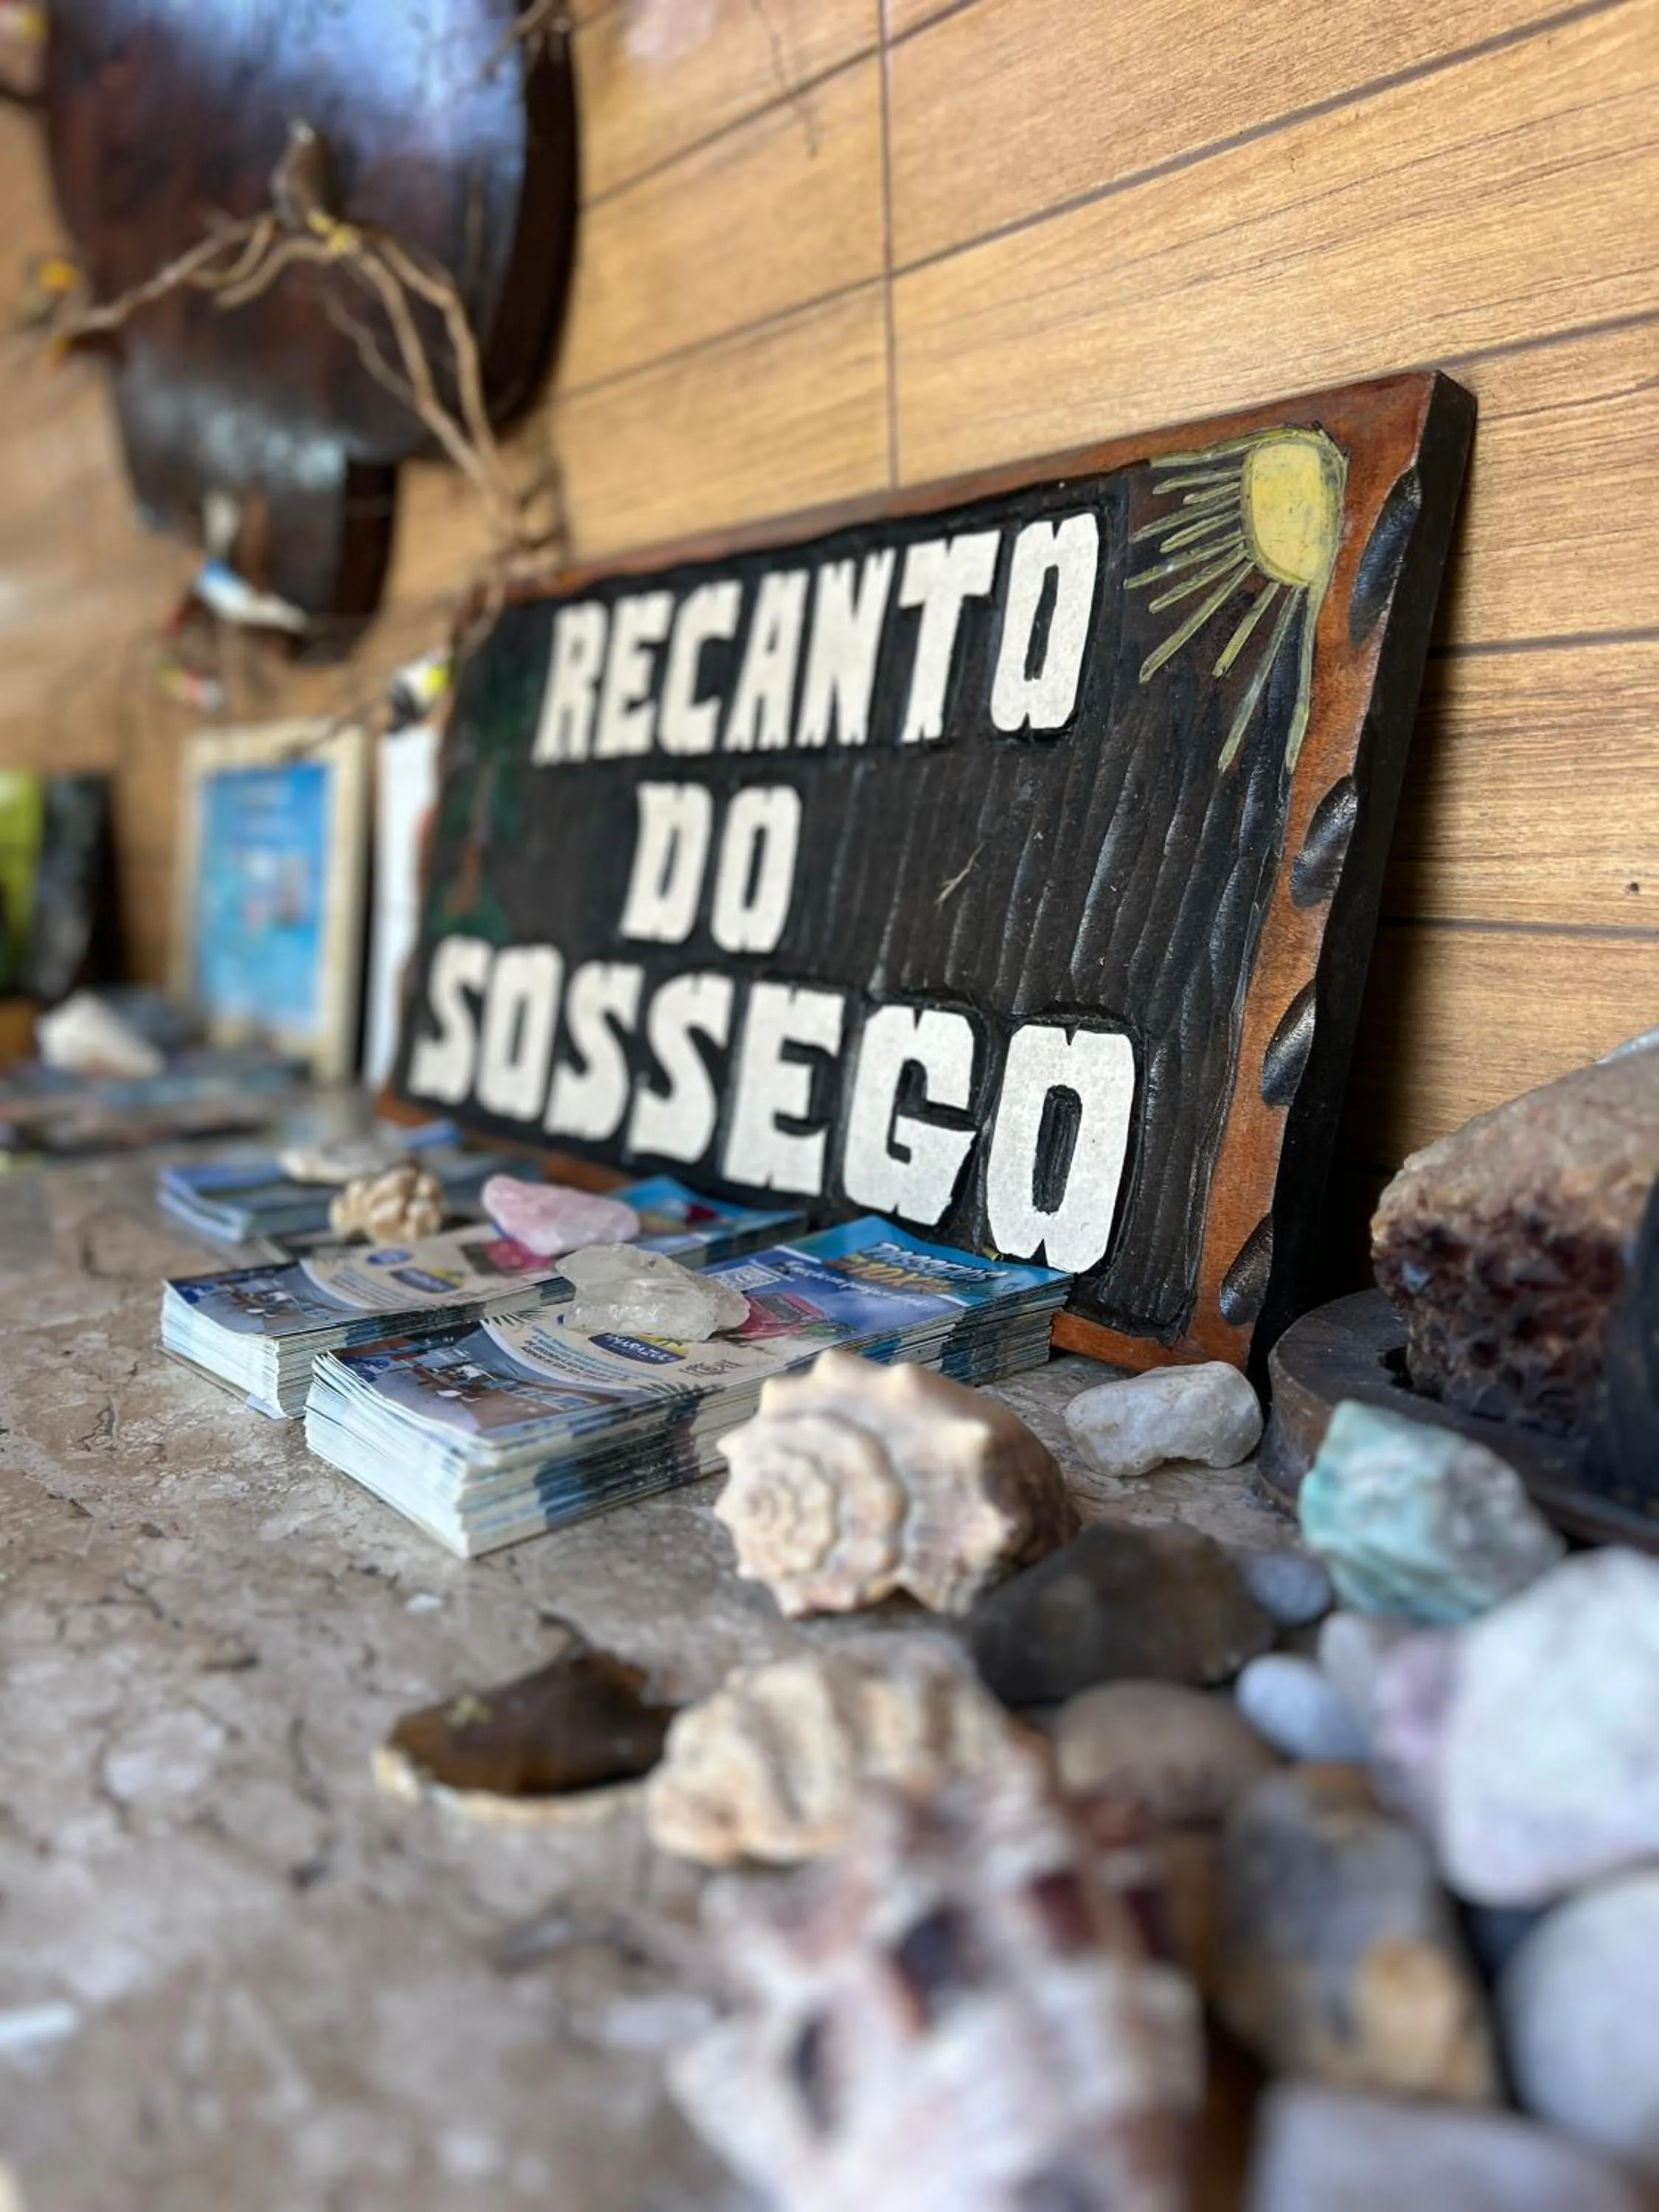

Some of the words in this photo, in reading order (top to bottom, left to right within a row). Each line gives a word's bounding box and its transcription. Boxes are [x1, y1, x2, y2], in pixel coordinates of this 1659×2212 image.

[533, 512, 1099, 766] RECANTO
[619, 782, 801, 953] DO
[407, 935, 1135, 1273] SOSSEGO
